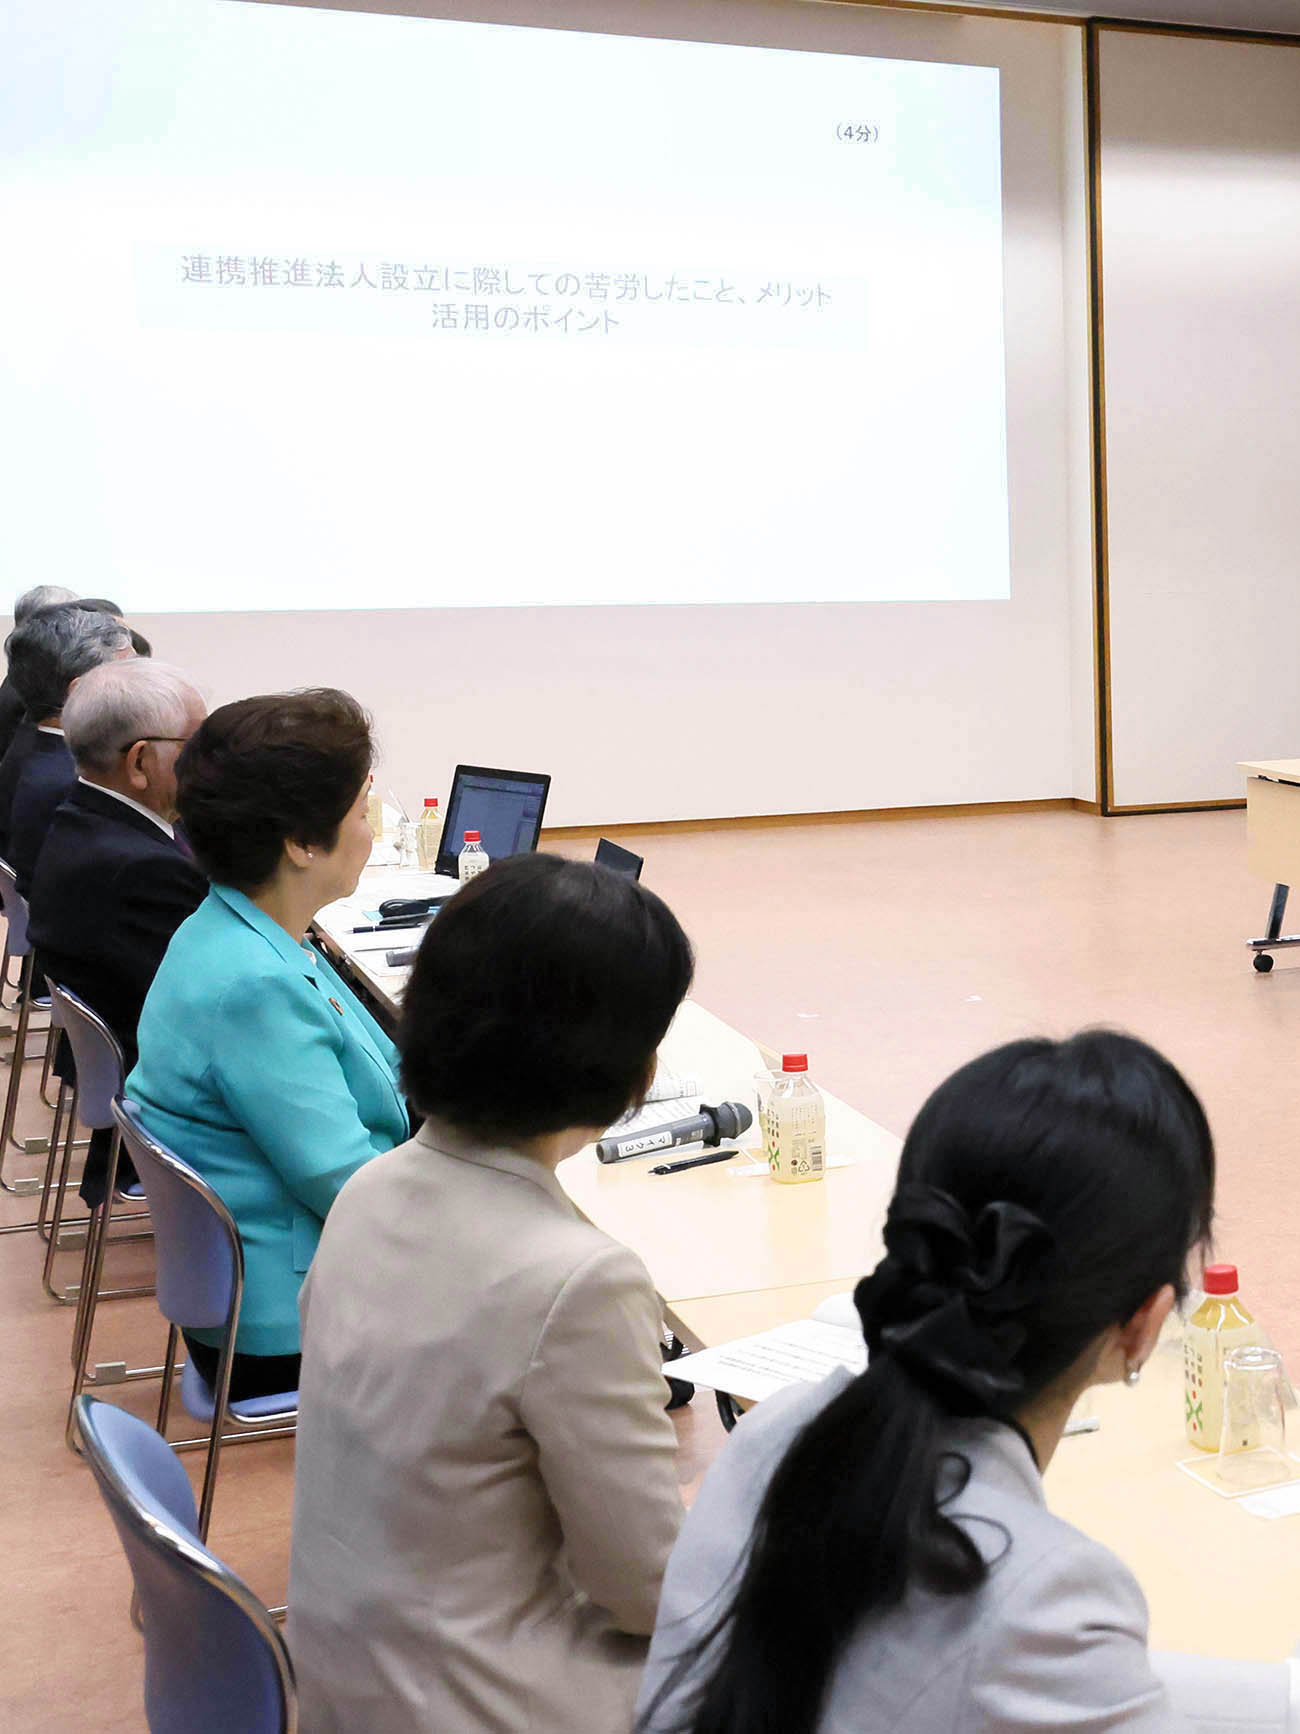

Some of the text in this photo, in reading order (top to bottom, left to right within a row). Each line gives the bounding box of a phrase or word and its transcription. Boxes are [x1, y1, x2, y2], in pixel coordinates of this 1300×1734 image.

[180, 253, 832, 307] 連携推進法人設立に際しての苦労したこと、メリット
[432, 302, 620, 334] 活用のポイント
